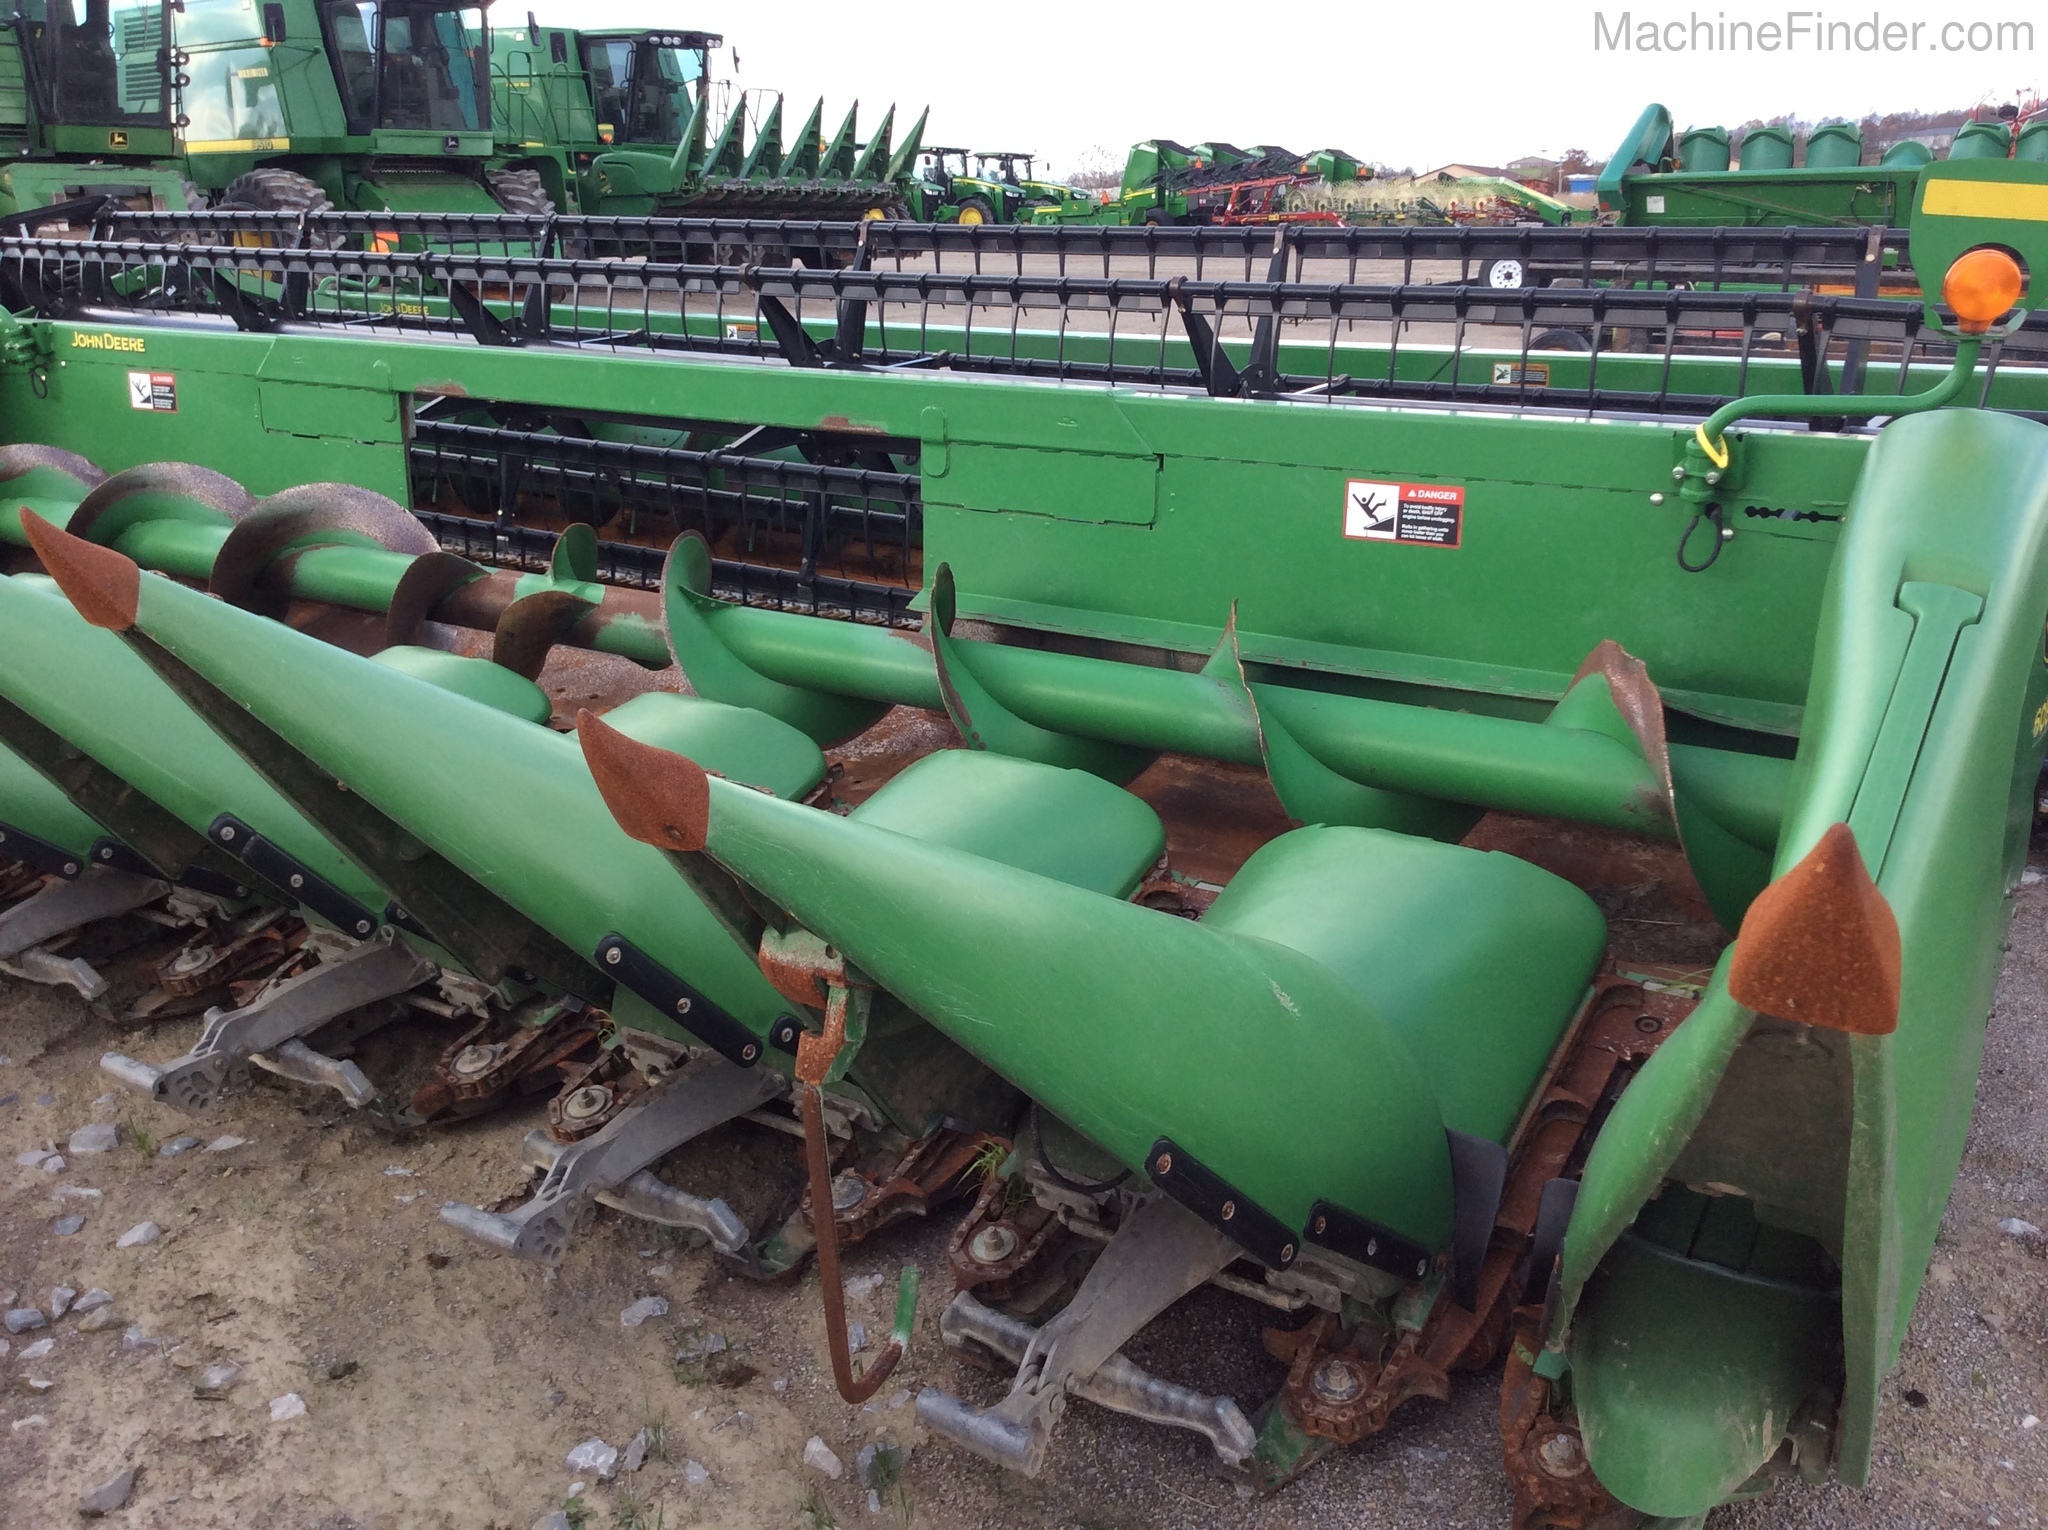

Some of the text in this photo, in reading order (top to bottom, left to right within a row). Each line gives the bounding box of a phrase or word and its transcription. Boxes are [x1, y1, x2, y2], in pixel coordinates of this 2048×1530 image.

[71, 331, 146, 353] JOHN DEERE
[1417, 489, 1457, 501] DANGER
